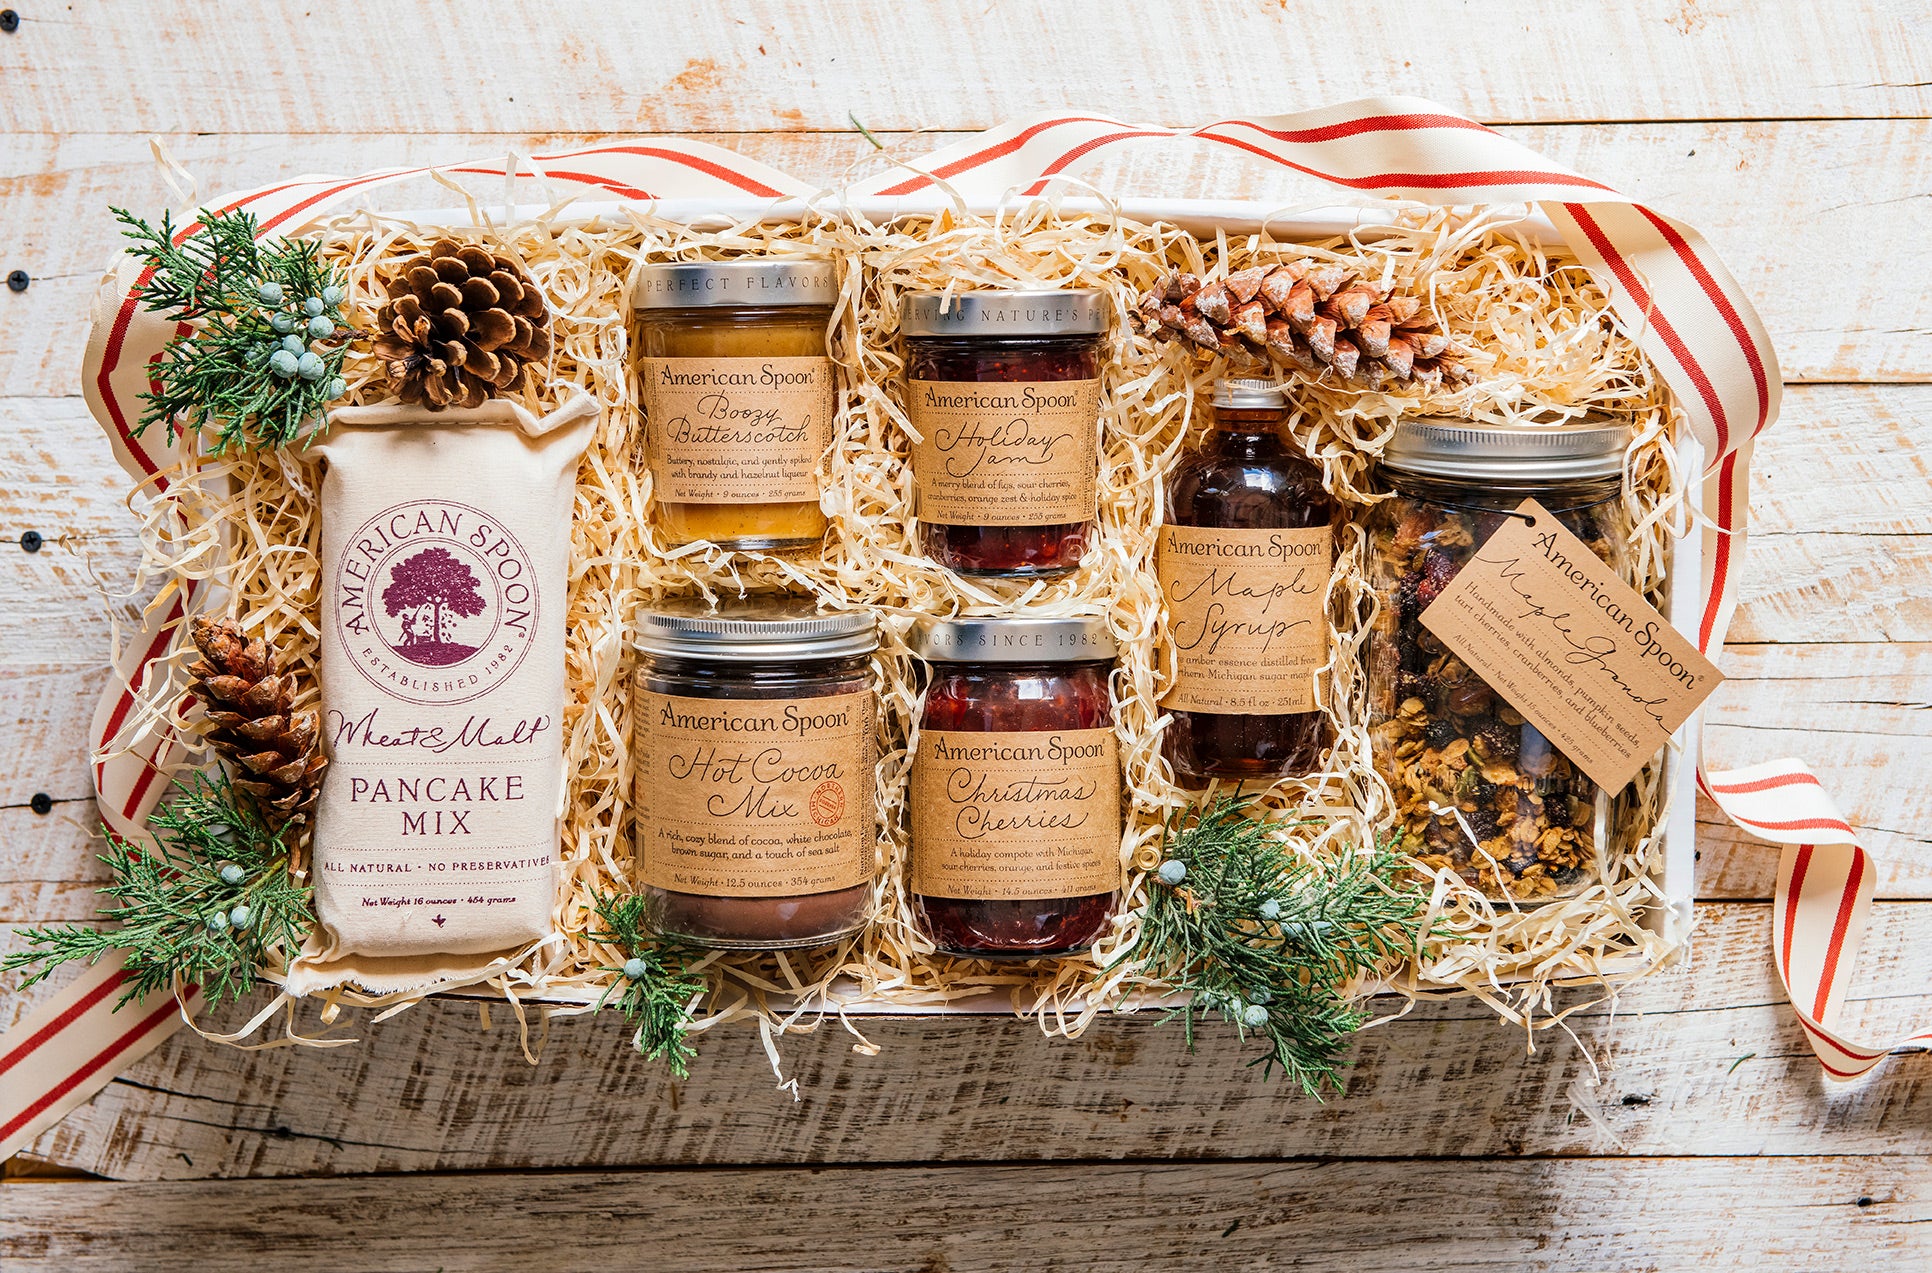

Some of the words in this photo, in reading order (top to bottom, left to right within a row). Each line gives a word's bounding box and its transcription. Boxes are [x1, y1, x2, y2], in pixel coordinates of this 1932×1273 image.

[647, 278, 729, 292] PERFECT
[747, 276, 830, 289] FLAVORS
[981, 309, 1079, 322] NATURE'S
[661, 364, 758, 386] American
[697, 390, 782, 427] Boozy
[925, 386, 1019, 409] American
[666, 414, 811, 444] Butterscotch
[935, 418, 1073, 458] Holiday
[697, 455, 739, 468] nostalgic,
[741, 455, 759, 465] and
[762, 455, 788, 468] gently
[789, 454, 812, 467] spiked
[946, 446, 1053, 478] Jam
[671, 469, 687, 478] with
[688, 469, 718, 482] brandy
[720, 469, 738, 479] and
[741, 468, 780, 479] hazelnut
[782, 469, 808, 480] liqueur
[931, 478, 938, 487] A
[938, 481, 961, 491] merry
[962, 480, 986, 489] blend
[988, 479, 997, 489] of
[998, 480, 1015, 492] figs,
[675, 489, 686, 497] Net
[688, 490, 713, 500] Weight
[722, 490, 729, 498] 9
[784, 490, 806, 500] grams
[968, 495, 998, 505] orange
[1000, 494, 1017, 503] zest
[1019, 492, 1029, 503] &
[1030, 492, 1060, 504] holiday
[1061, 491, 1077, 502] spice
[937, 511, 948, 519] Net
[949, 511, 975, 522] Weight
[1044, 513, 1067, 522] grams
[1167, 531, 1265, 557] American
[342, 509, 463, 636] AMERICAN
[1531, 529, 1634, 633] American
[1171, 567, 1320, 614] Maple
[978, 634, 1044, 647] SINCE
[1058, 633, 1098, 646] 1982
[1174, 602, 1312, 655] Syrup
[1474, 555, 1585, 651] Maple
[1564, 635, 1672, 735] Granola
[362, 647, 478, 692] ESTABLISHED
[484, 644, 514, 675] 1982
[1186, 654, 1216, 665] amber
[1218, 659, 1258, 667] essence
[1260, 655, 1299, 667] distilled
[1300, 654, 1317, 665] from
[1464, 581, 1515, 632] Handmade
[1515, 630, 1536, 651] with
[1535, 650, 1576, 689] almonds,
[1573, 687, 1614, 724] pumpkin
[1614, 723, 1640, 749] seeds,
[1207, 668, 1256, 684] Michigan
[1259, 673, 1289, 684] sugar
[1454, 595, 1473, 613] tart
[1473, 613, 1511, 650] cherries,
[1512, 649, 1563, 699] cranberries,
[1565, 697, 1587, 715] and
[1584, 710, 1632, 759] blueberries
[1178, 693, 1189, 703] All
[1190, 694, 1223, 706] Natural
[1230, 697, 1246, 707] 8.5
[1248, 696, 1257, 707] fl
[1453, 634, 1467, 646] All
[1464, 642, 1492, 669] Natural
[1494, 670, 1507, 684] Net
[1506, 679, 1528, 704] Weight
[1527, 701, 1536, 711] 15
[1535, 708, 1557, 731] ounces
[1560, 731, 1574, 746] 425
[1572, 743, 1594, 764] grams
[660, 701, 778, 732] American
[328, 707, 422, 748] Wheat
[433, 715, 551, 754] Malt
[934, 736, 1045, 761] American
[668, 746, 751, 784] Hot
[751, 748, 845, 783] Cocoa
[350, 775, 525, 803] PANCAKE
[946, 766, 1097, 804] Christmas
[707, 785, 799, 818] Mix
[401, 810, 472, 836] MIX
[955, 805, 1089, 840] Cherries
[658, 828, 665, 838] A
[666, 830, 684, 843] rich,
[685, 835, 706, 847] cozy
[708, 833, 736, 846] blend
[738, 835, 750, 846] of
[751, 838, 783, 847] cocoa,
[786, 833, 812, 845] white
[814, 828, 853, 843] chocolate,
[671, 843, 698, 857] brown
[700, 850, 729, 864] sugar,
[731, 850, 752, 860] and
[755, 852, 763, 860] a
[765, 848, 793, 860] touch
[796, 846, 806, 857] of
[808, 848, 823, 857] sea
[824, 843, 840, 855] salt
[950, 848, 958, 857] A
[959, 848, 992, 861] holiday
[994, 850, 1034, 861] compote
[1036, 848, 1055, 858] with
[1057, 846, 1094, 858] Michigan
[324, 861, 345, 873] ALL
[350, 863, 412, 873] NATURAL
[428, 862, 446, 872] NO
[941, 863, 959, 871] sour
[960, 862, 997, 872] cherries,
[998, 864, 1034, 875] orange,
[1036, 862, 1054, 871] and
[1056, 860, 1081, 870] festive
[674, 873, 687, 884] Net
[690, 876, 719, 889] Weight
[726, 878, 746, 888] 12.5
[748, 880, 783, 888] ounces
[790, 876, 809, 887] 354
[810, 875, 836, 888] grams
[948, 885, 961, 894] Net
[962, 886, 992, 898] Weight
[1002, 887, 1020, 896] 14.5
[1074, 884, 1097, 894] grams
[362, 897, 378, 907] Net
[380, 896, 411, 908] Weight
[413, 897, 424, 906] 16
[487, 896, 517, 906] grams
